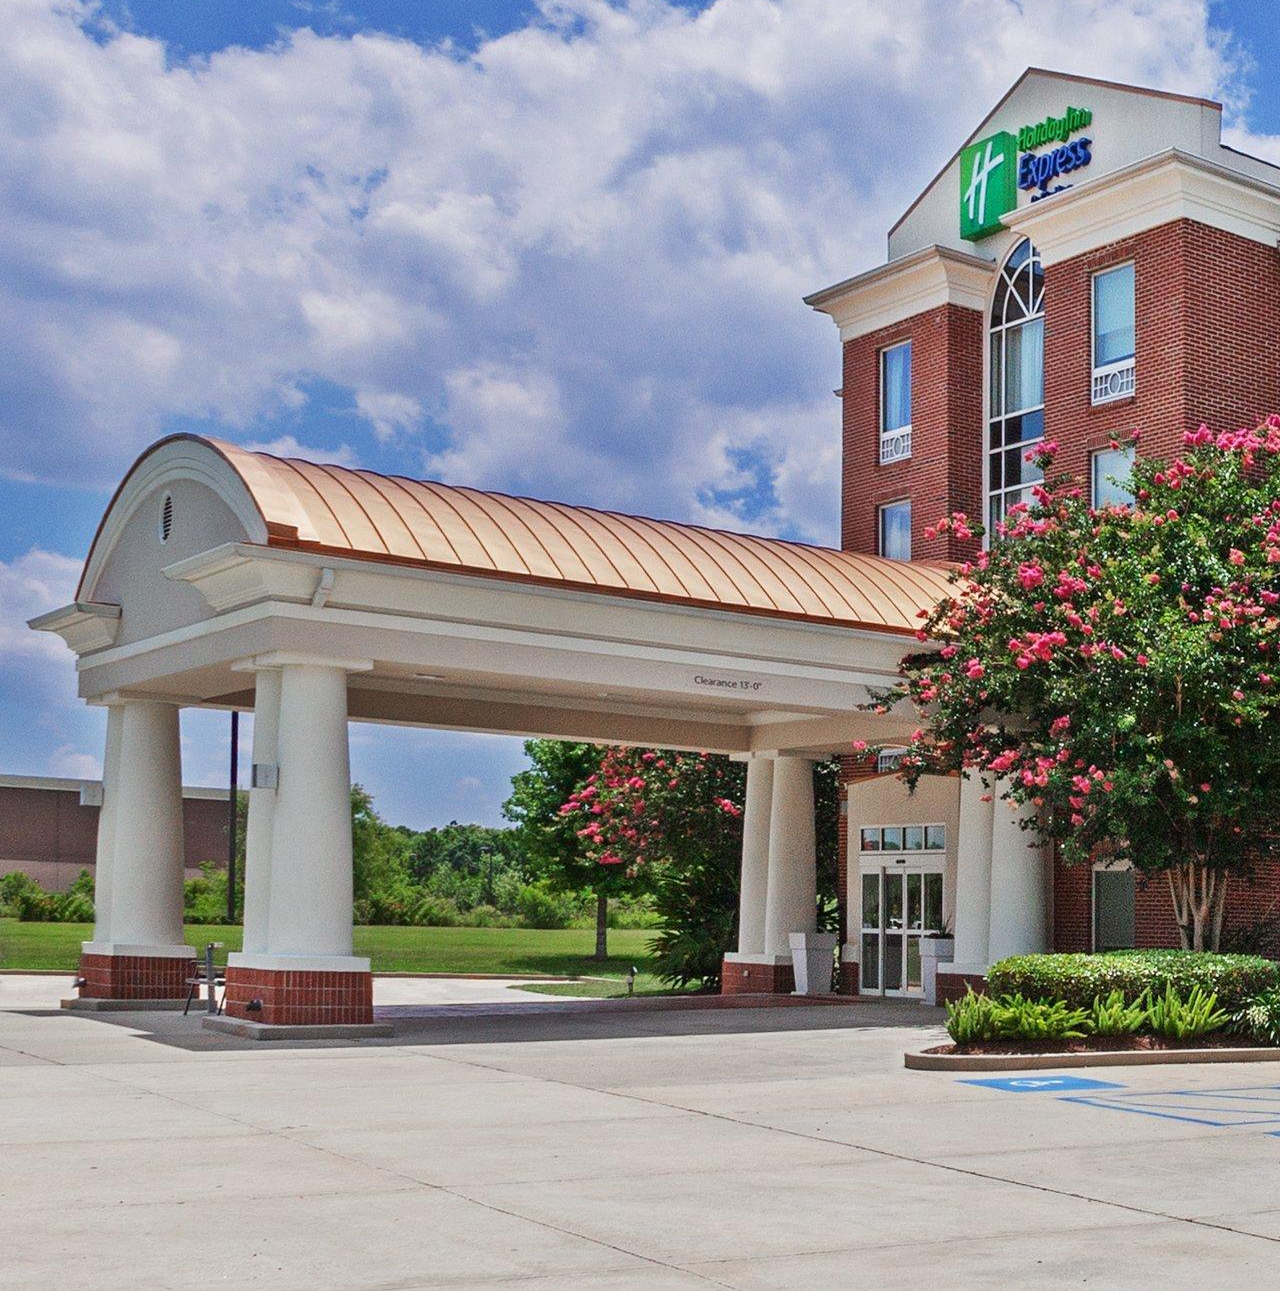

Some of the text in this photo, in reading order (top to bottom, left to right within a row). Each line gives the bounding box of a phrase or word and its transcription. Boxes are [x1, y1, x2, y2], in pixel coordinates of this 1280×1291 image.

[1019, 106, 1092, 152] Holiday Inn
[1018, 137, 1092, 191] Express
[694, 675, 738, 689] Clearance
